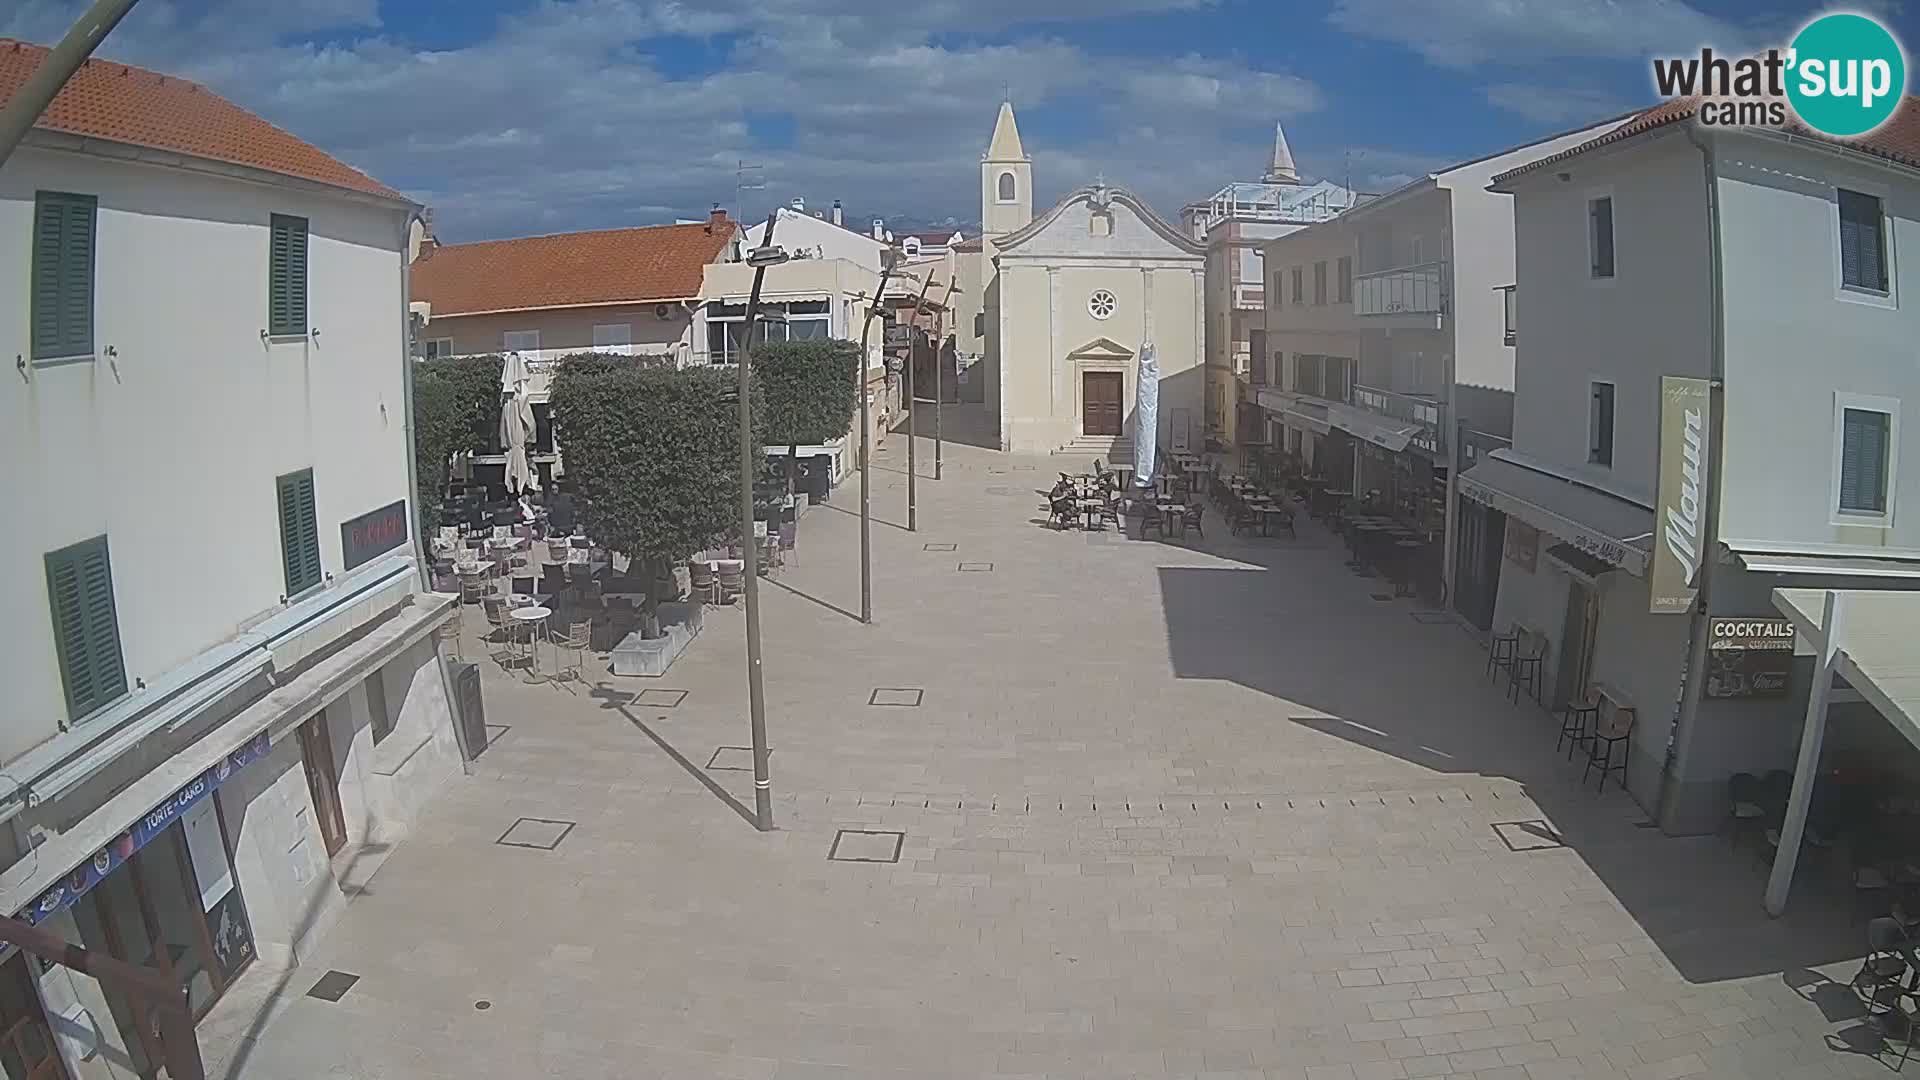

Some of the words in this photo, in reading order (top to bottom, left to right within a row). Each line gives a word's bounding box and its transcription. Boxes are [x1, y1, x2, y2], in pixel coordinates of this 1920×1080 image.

[1715, 623, 1795, 638] COCKTAILS
[145, 801, 174, 831] TORTE
[178, 778, 205, 806] CAKES
